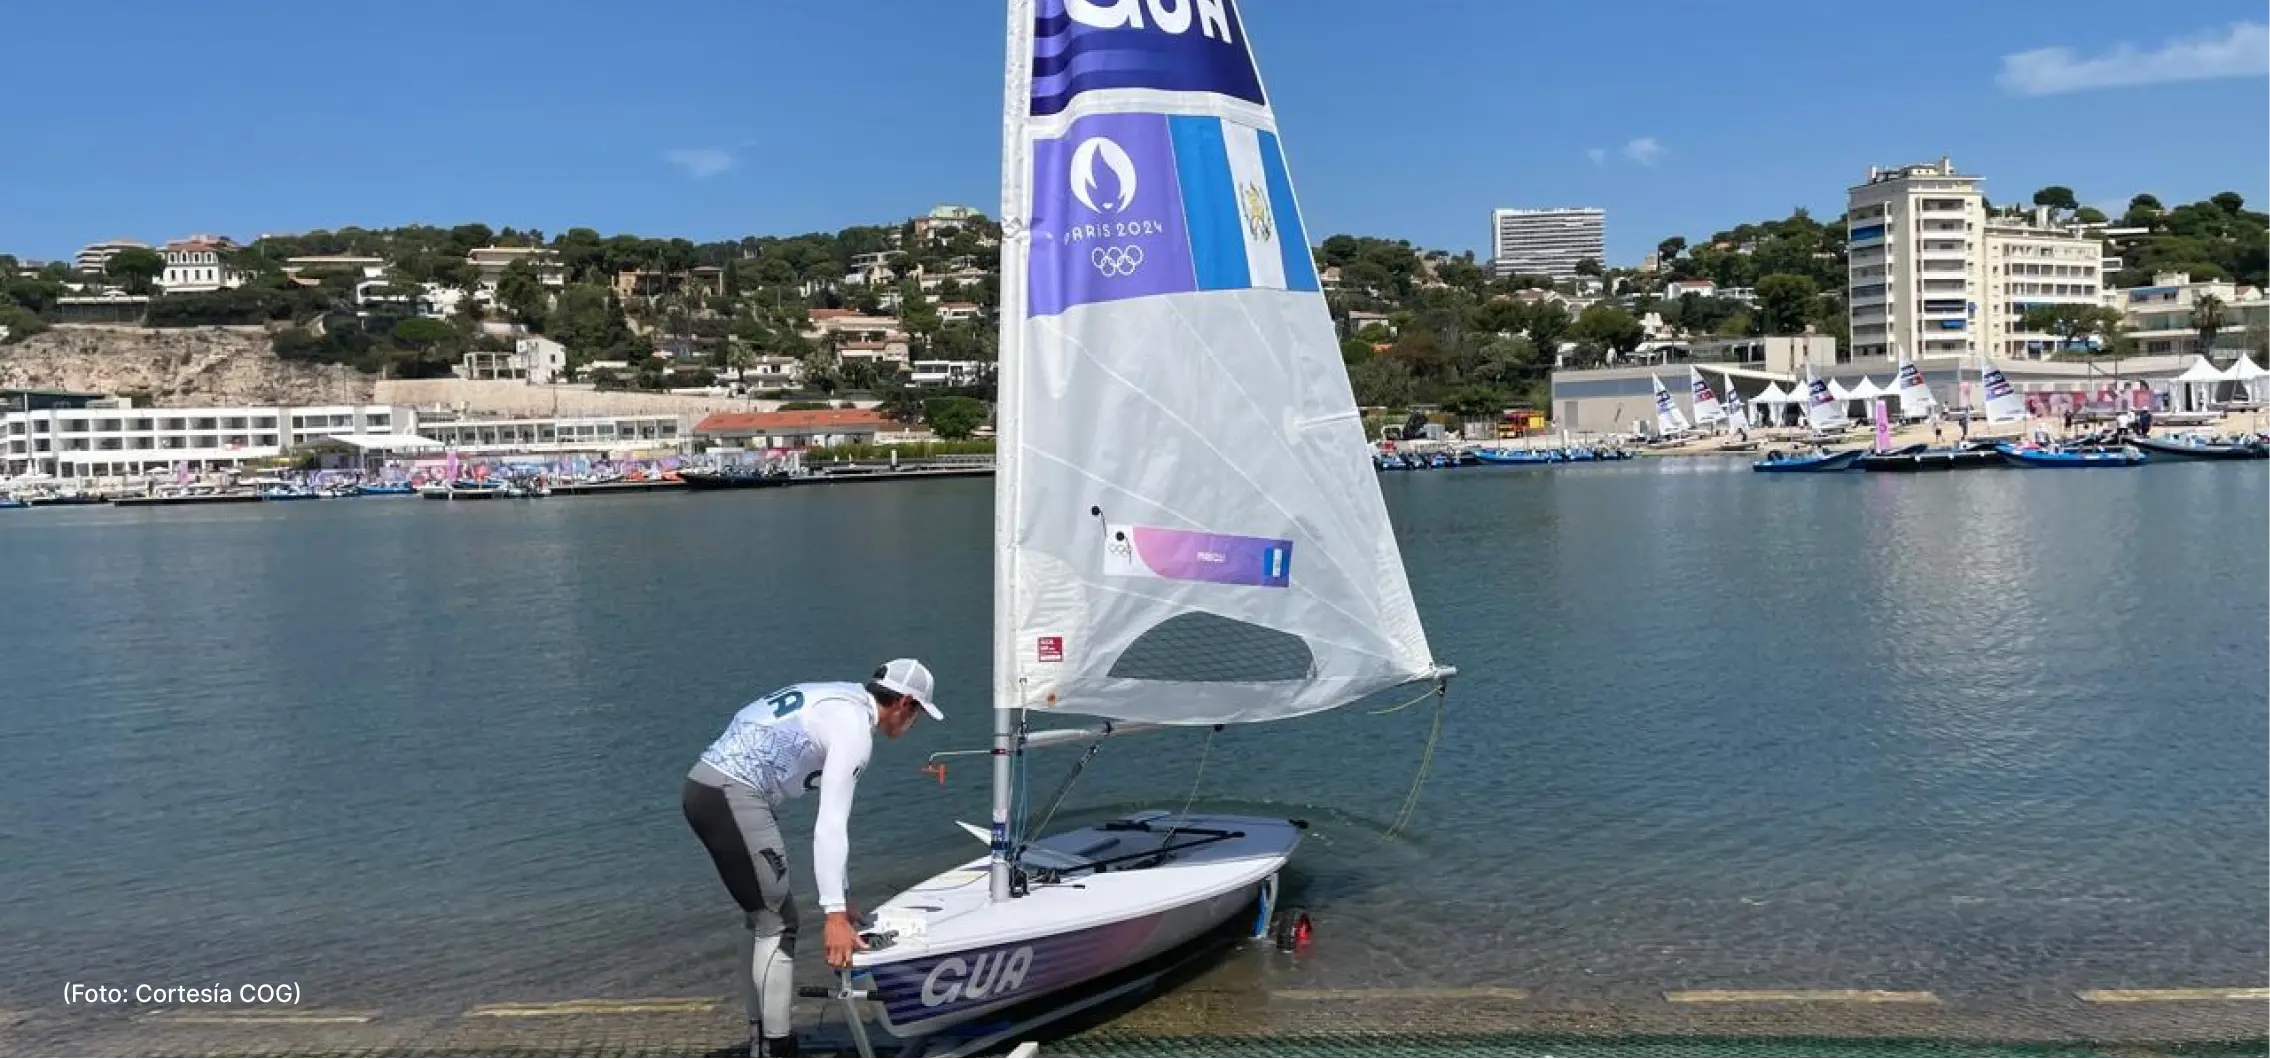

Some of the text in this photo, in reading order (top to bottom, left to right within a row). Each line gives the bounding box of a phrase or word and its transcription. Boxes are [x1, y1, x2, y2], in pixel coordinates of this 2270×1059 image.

[1063, 219, 1163, 245] PARIS 2024
[921, 945, 1034, 1007] GUA
